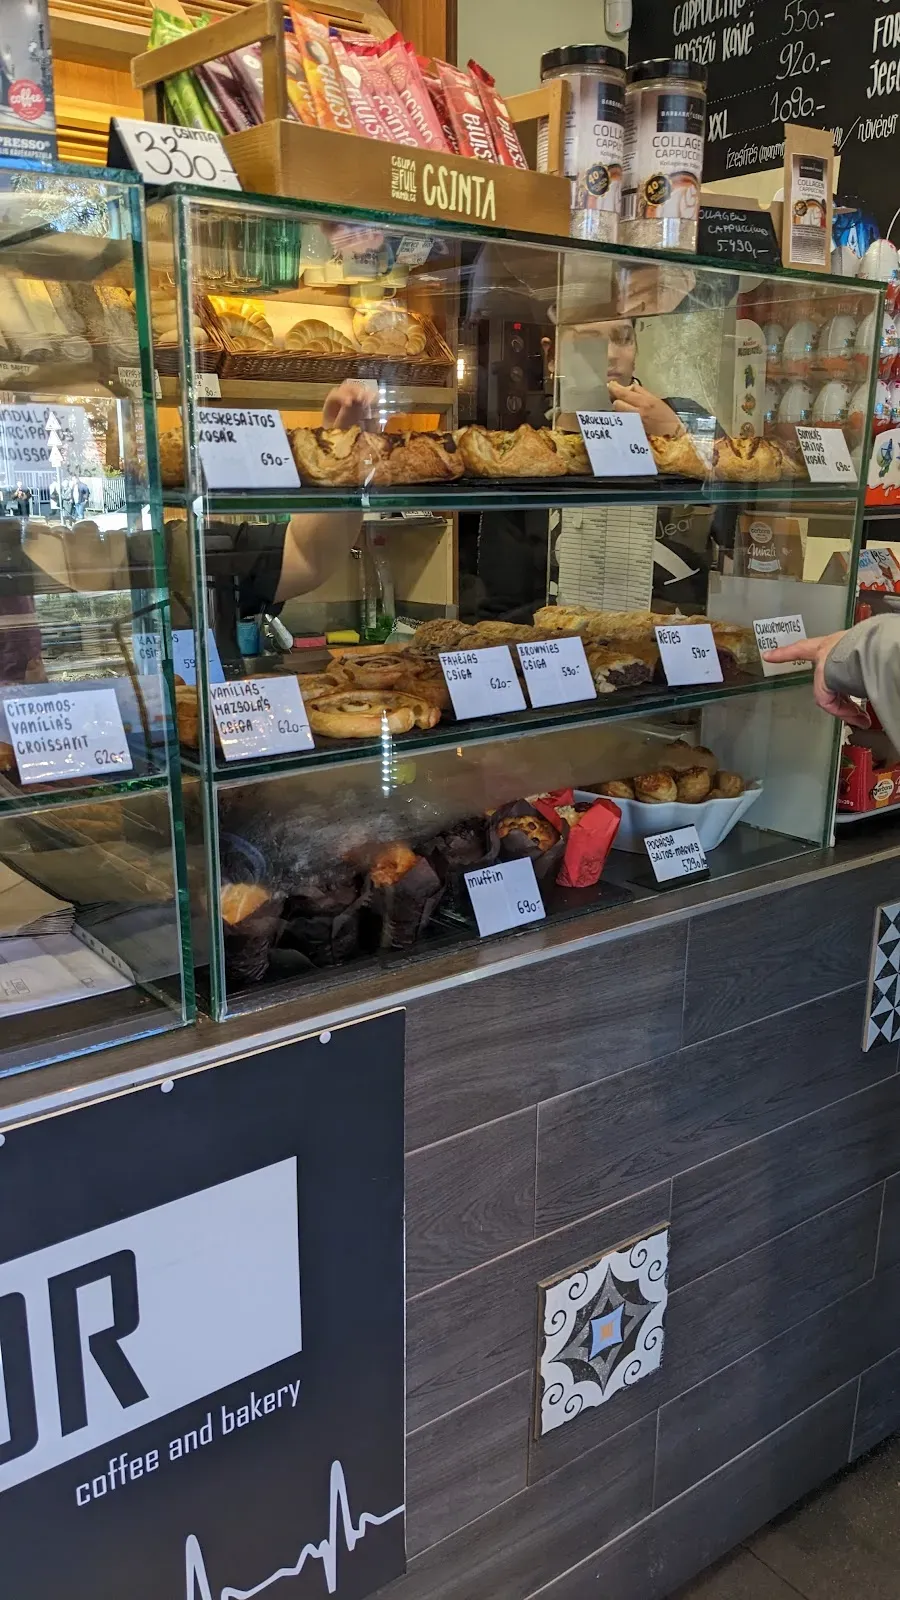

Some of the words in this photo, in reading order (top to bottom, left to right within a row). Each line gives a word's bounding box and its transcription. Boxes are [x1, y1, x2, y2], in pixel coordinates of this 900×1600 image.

[673, 0, 746, 36] CAPPUCCIN
[722, 10, 755, 62] KÁVÉ
[775, 41, 831, 80] 920.-
[422, 163, 497, 222] CSINTA
[579, 414, 623, 427] BROKKOLIS
[584, 427, 612, 440] KOSÁR
[658, 629, 681, 645] RÉTES
[519, 642, 560, 657] BROWNIES
[523, 656, 547, 671] CSIGA
[446, 667, 473, 681] CSIGA
[215, 697, 271, 716] MAZSOLÁS
[11, 714, 73, 735] VANÍLIÁS
[17, 735, 89, 755] CROISSANT
[468, 869, 504, 888] muffin
[75, 1450, 160, 1507] coffee
[168, 1413, 214, 1462] and
[221, 1378, 301, 1435] bakery
